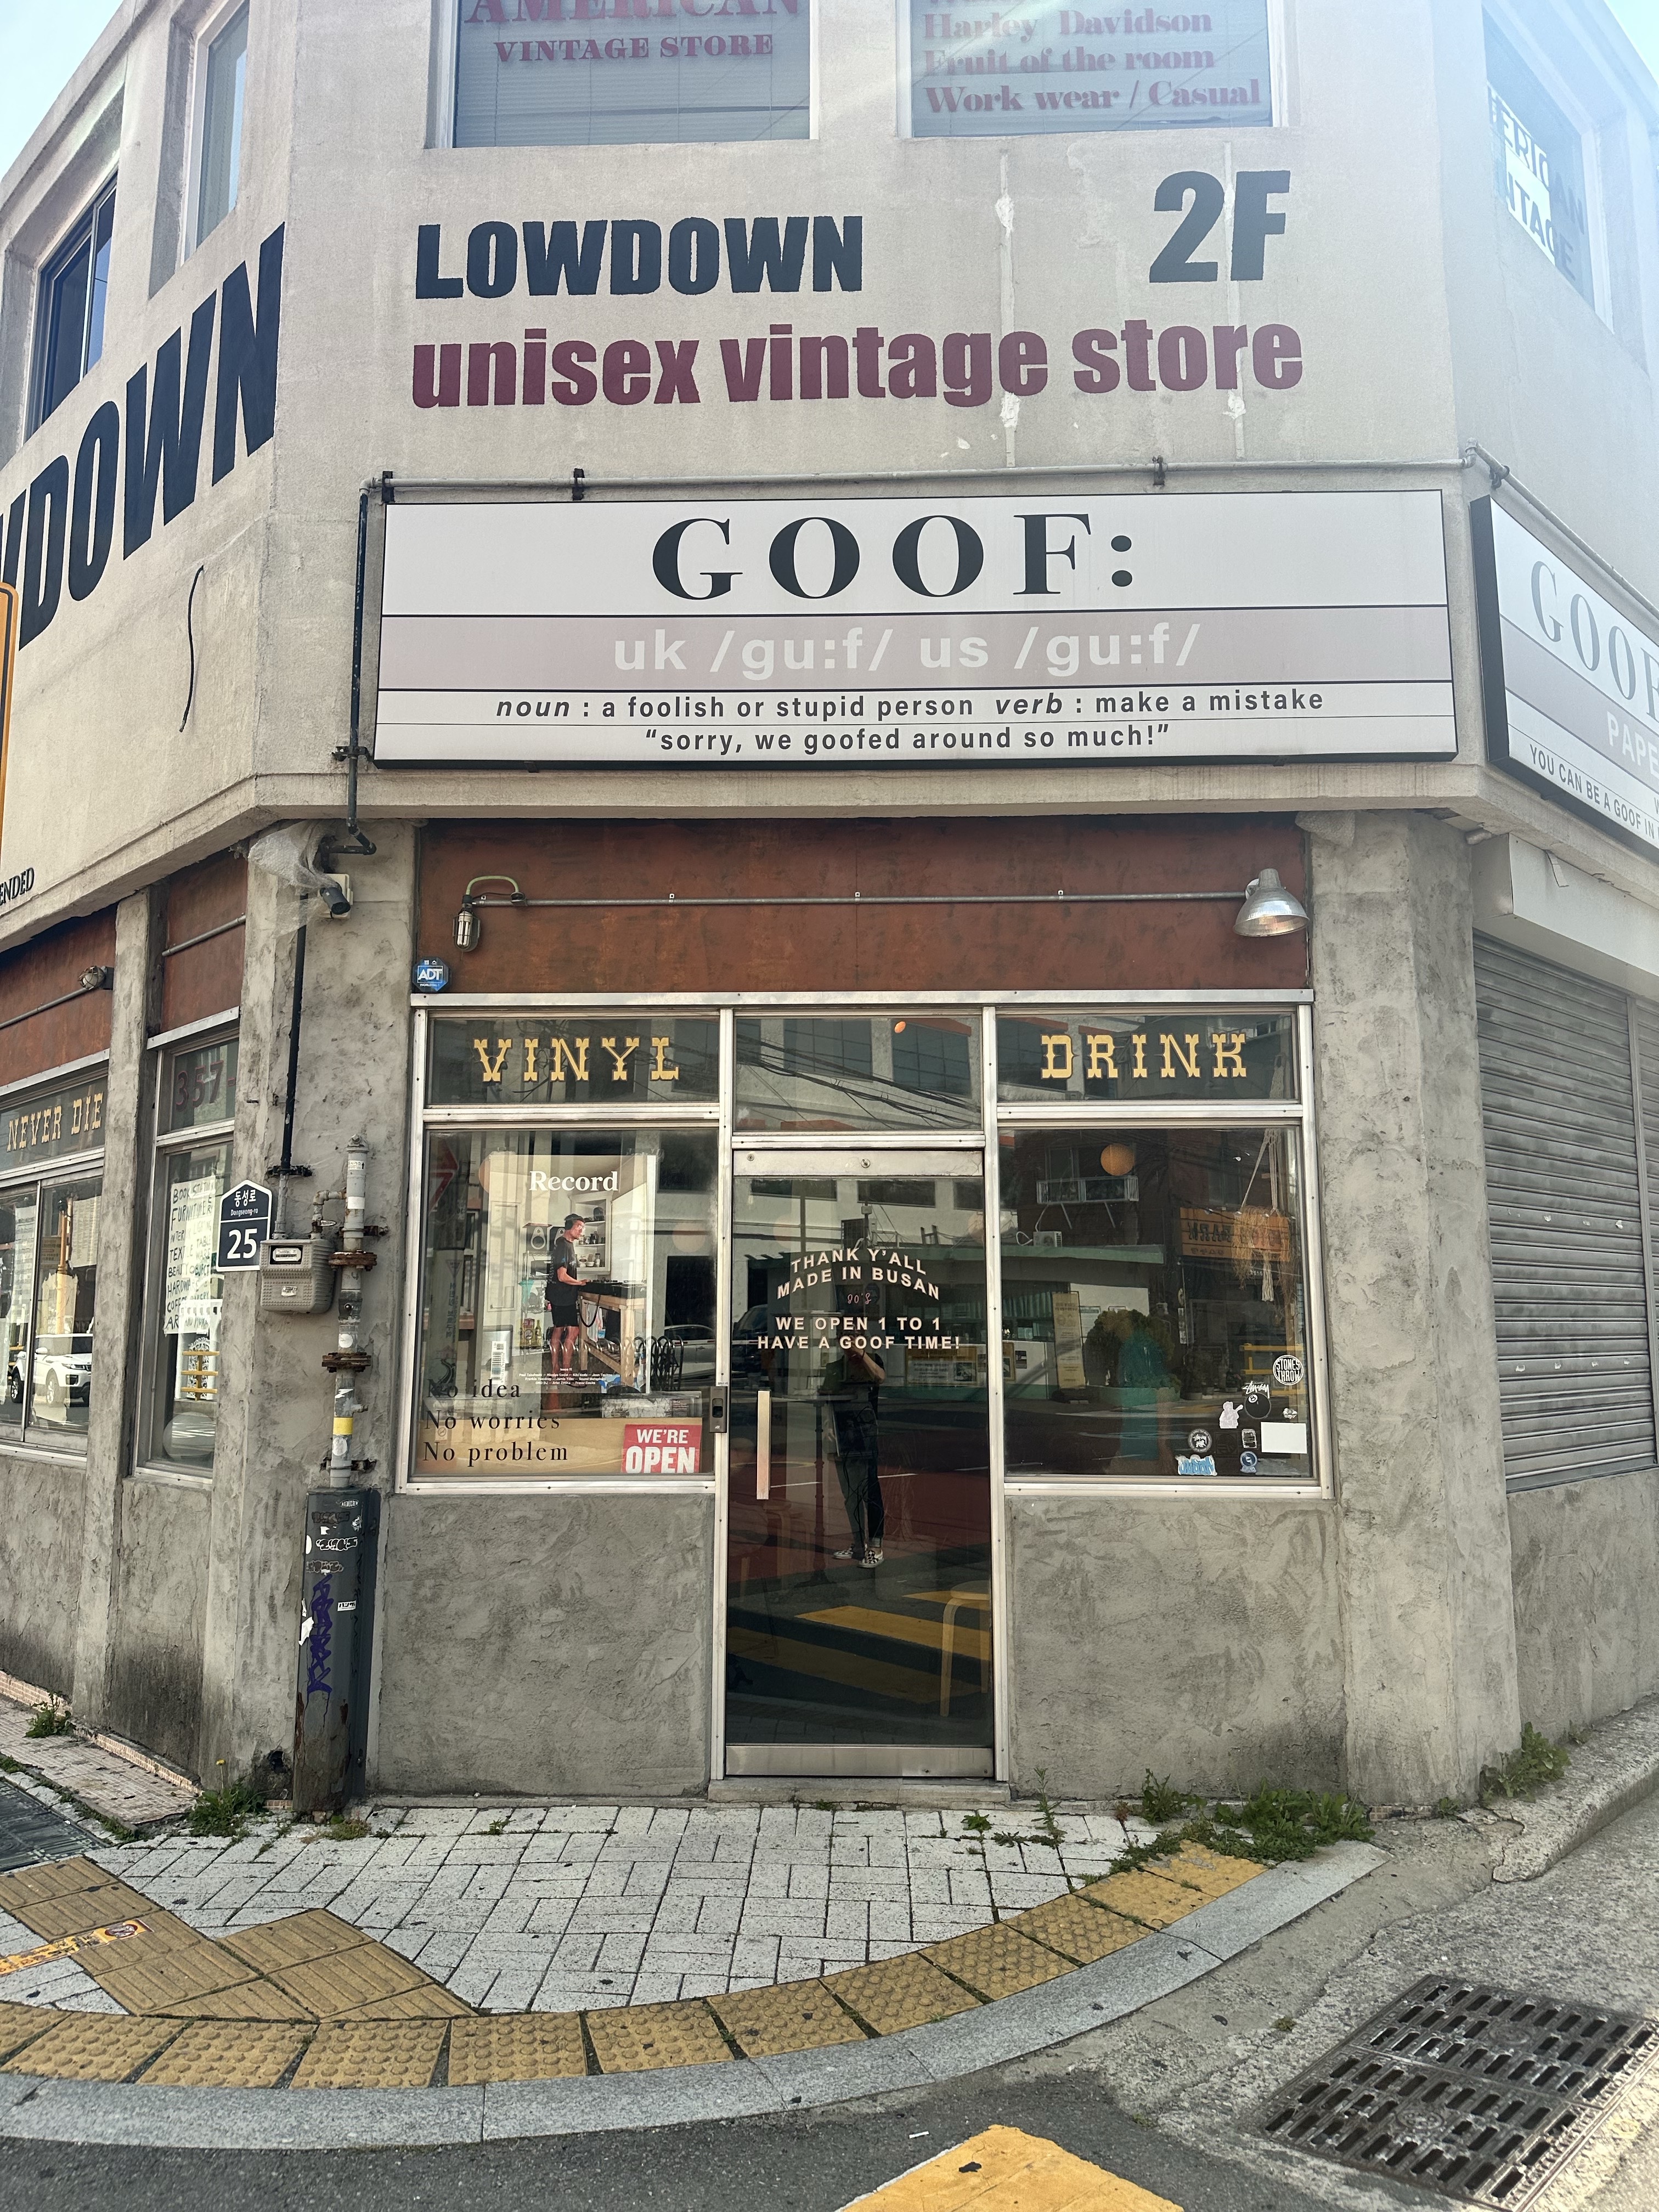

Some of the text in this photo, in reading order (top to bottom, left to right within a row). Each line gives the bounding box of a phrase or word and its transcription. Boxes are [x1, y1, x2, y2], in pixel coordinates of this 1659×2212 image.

[924, 8, 1212, 43] Harley Davidson
[494, 34, 774, 62] VINTAGE STORE
[924, 46, 1215, 75] Fruit of the room
[925, 84, 1025, 113] Work
[1035, 90, 1120, 111] wear
[1149, 78, 1261, 106] Casual
[1149, 170, 1291, 283] 2F
[415, 216, 863, 300] LOWDOWN
[412, 319, 1303, 409] unisex vintage store
[652, 514, 1133, 600] GOOF:
[614, 629, 687, 670] uk
[920, 637, 989, 667] us
[496, 701, 569, 718] noun
[602, 703, 615, 718] a
[628, 696, 724, 718] foolish
[737, 702, 764, 718] or
[776, 696, 864, 721] stupid
[877, 699, 973, 721] person
[996, 692, 1063, 715] verb
[1096, 691, 1169, 713] make
[1182, 696, 1195, 712] a
[1209, 689, 1323, 711] mistake
[755, 733, 791, 750] we
[804, 728, 900, 755] goofed
[912, 727, 1011, 749] around
[1024, 731, 1054, 747] so
[1530, 743, 1554, 776] YOU
[1559, 763, 1583, 793] CAN
[1585, 780, 1600, 805] BE
[1604, 792, 1611, 811] A
[1613, 799, 1641, 830] GOOF
[1644, 818, 1655, 839] IN
[417, 968, 442, 980] ADT
[473, 1037, 679, 1082] VINYL
[1040, 1032, 1247, 1079] DRINK
[7, 1091, 103, 1152] NEVER DIE
[529, 1170, 619, 1192] Record
[234, 1189, 256, 1207] 동성로
[227, 1228, 258, 1260] 25
[791, 1248, 927, 1275] THANK Y'ALL
[777, 1266, 940, 1301] MADE IN BUSAN
[775, 1317, 940, 1330] WE OPEN 1 TO 1
[757, 1335, 960, 1350] HAVE A GOOF TIME!
[1276, 1358, 1300, 1370] STONES
[1276, 1370, 1300, 1383] THROW
[472, 1379, 521, 1398] idea
[425, 1410, 560, 1430] No worries
[636, 1429, 690, 1444] WE'RE
[422, 1441, 568, 1467] No problem
[625, 1446, 696, 1474] OPEN
